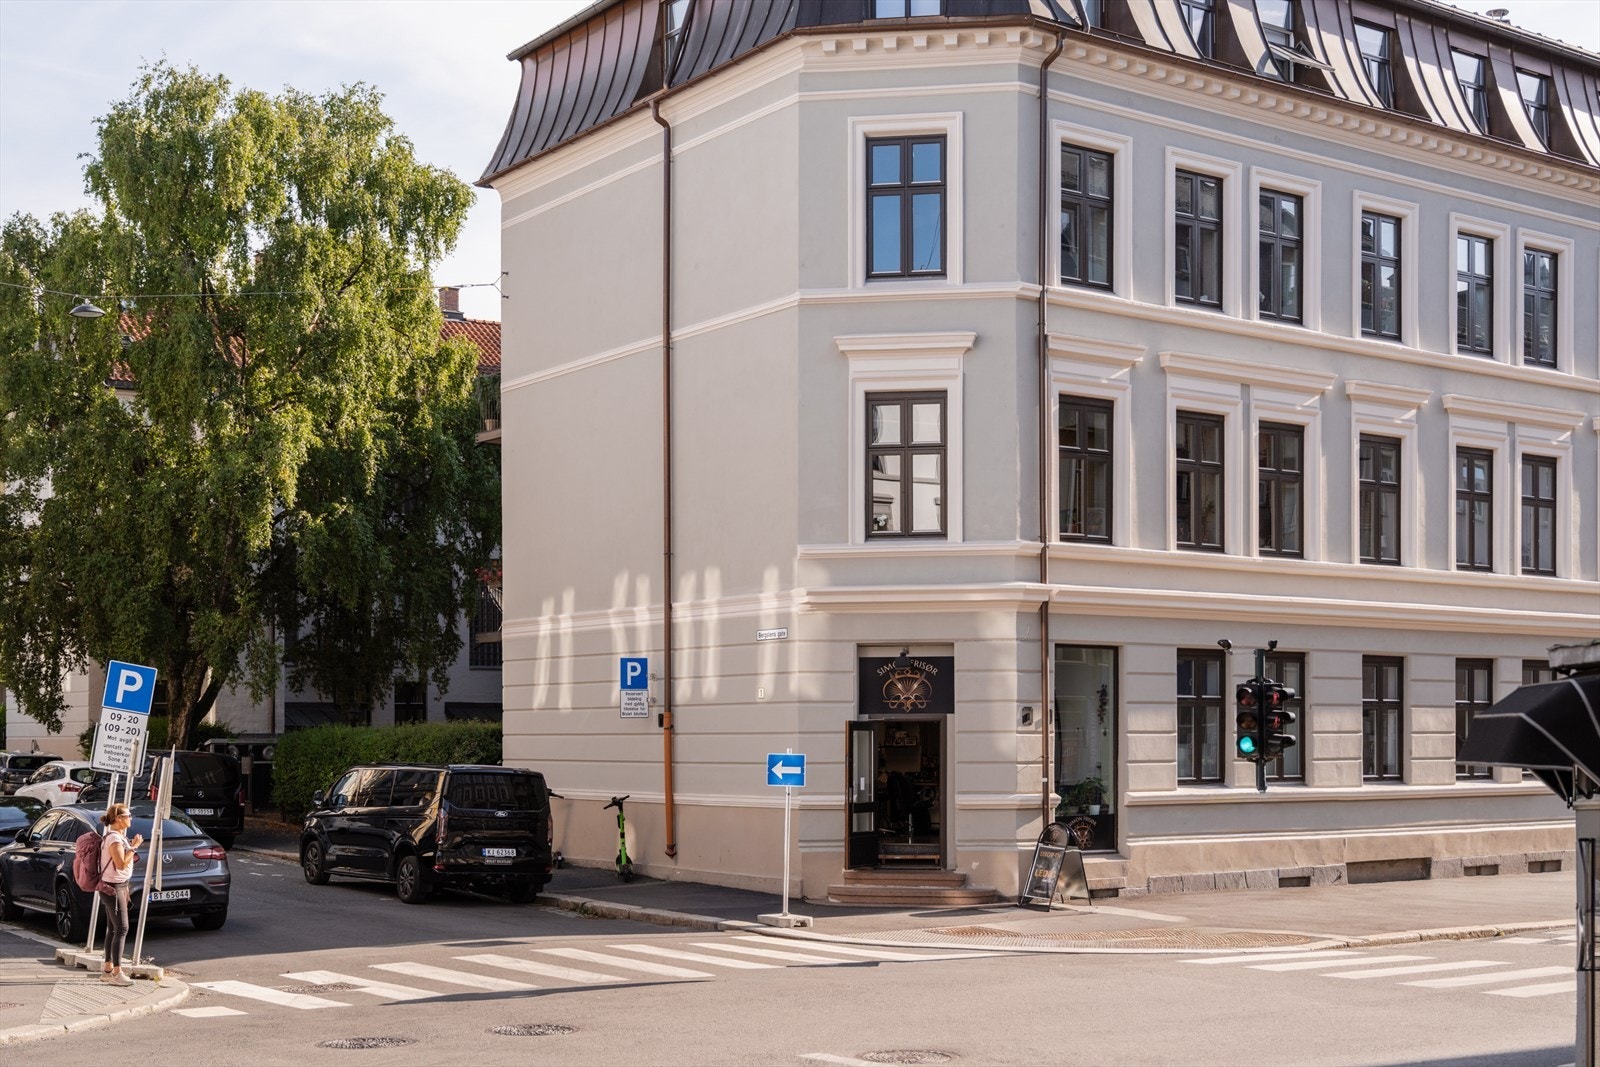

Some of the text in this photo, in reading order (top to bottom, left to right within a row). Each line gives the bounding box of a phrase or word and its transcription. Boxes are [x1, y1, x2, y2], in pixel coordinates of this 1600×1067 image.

[627, 661, 641, 686] P
[876, 661, 897, 676] SIM
[115, 669, 143, 703] P
[103, 743, 122, 751] unntatt
[103, 749, 130, 758] beboerkor
[107, 755, 121, 763] Sone
[153, 890, 189, 900] BT 65044
